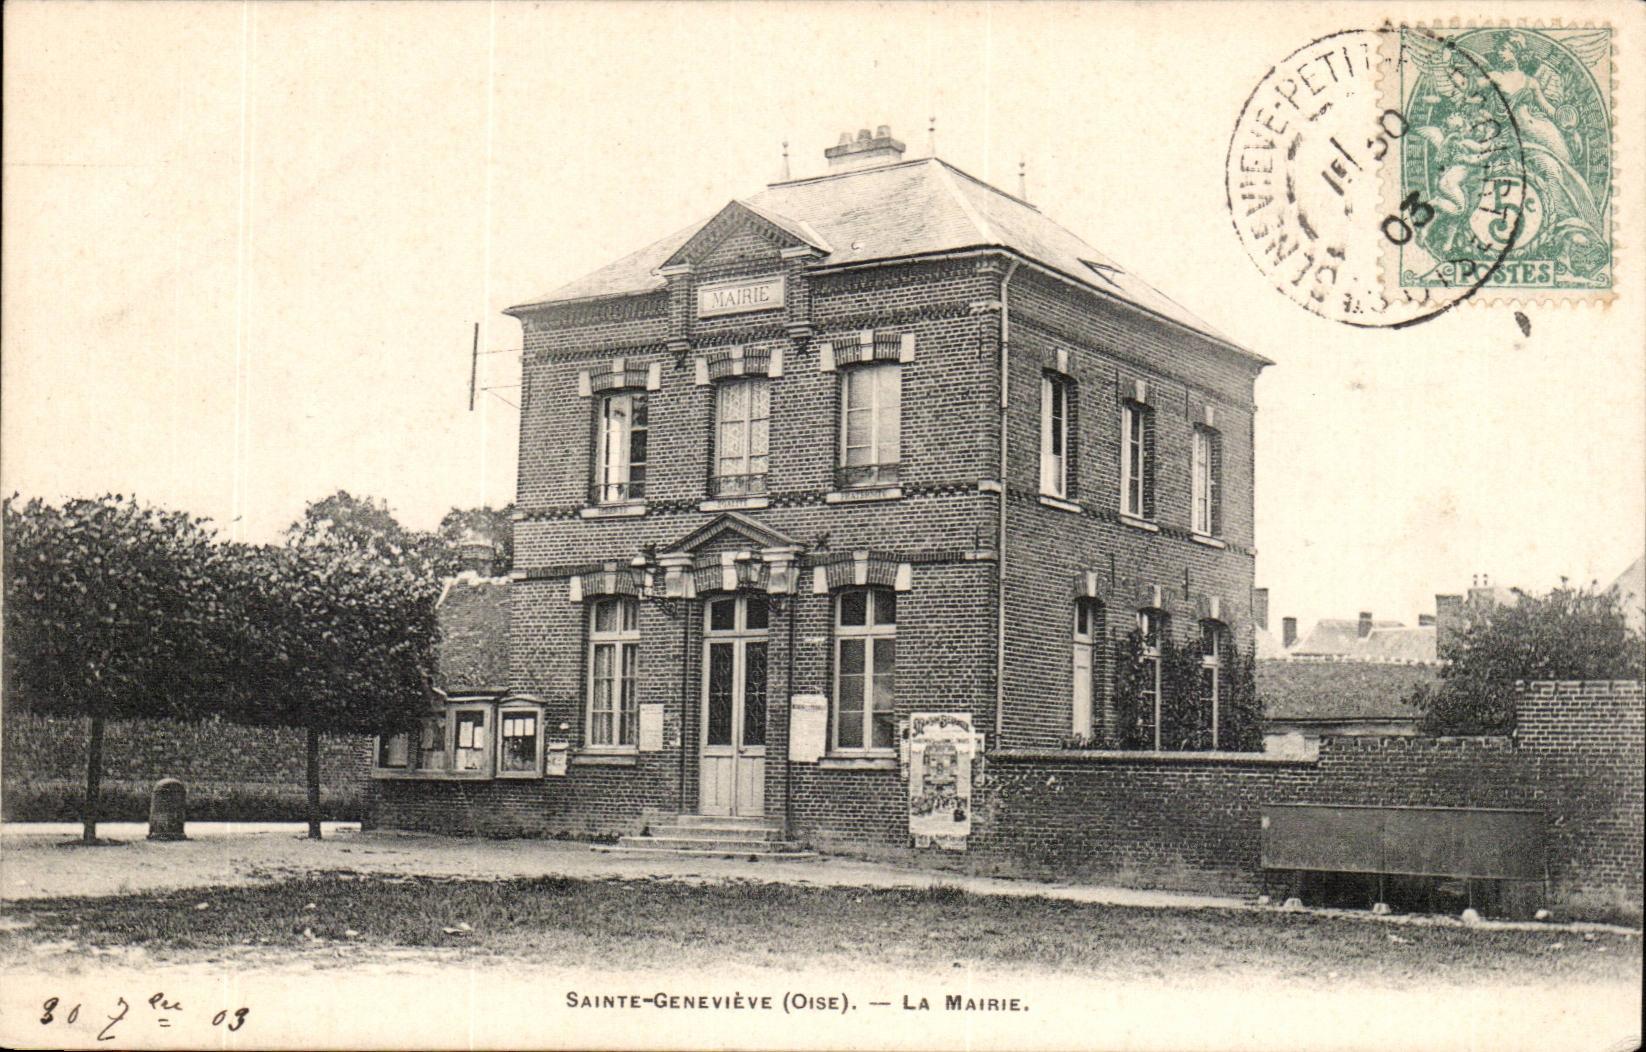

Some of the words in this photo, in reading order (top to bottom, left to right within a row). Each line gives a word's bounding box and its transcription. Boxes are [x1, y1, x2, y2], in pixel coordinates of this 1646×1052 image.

[1381, 190, 1435, 246] 03
[1459, 260, 1551, 285] POSTES
[711, 285, 769, 309] MAIRIE
